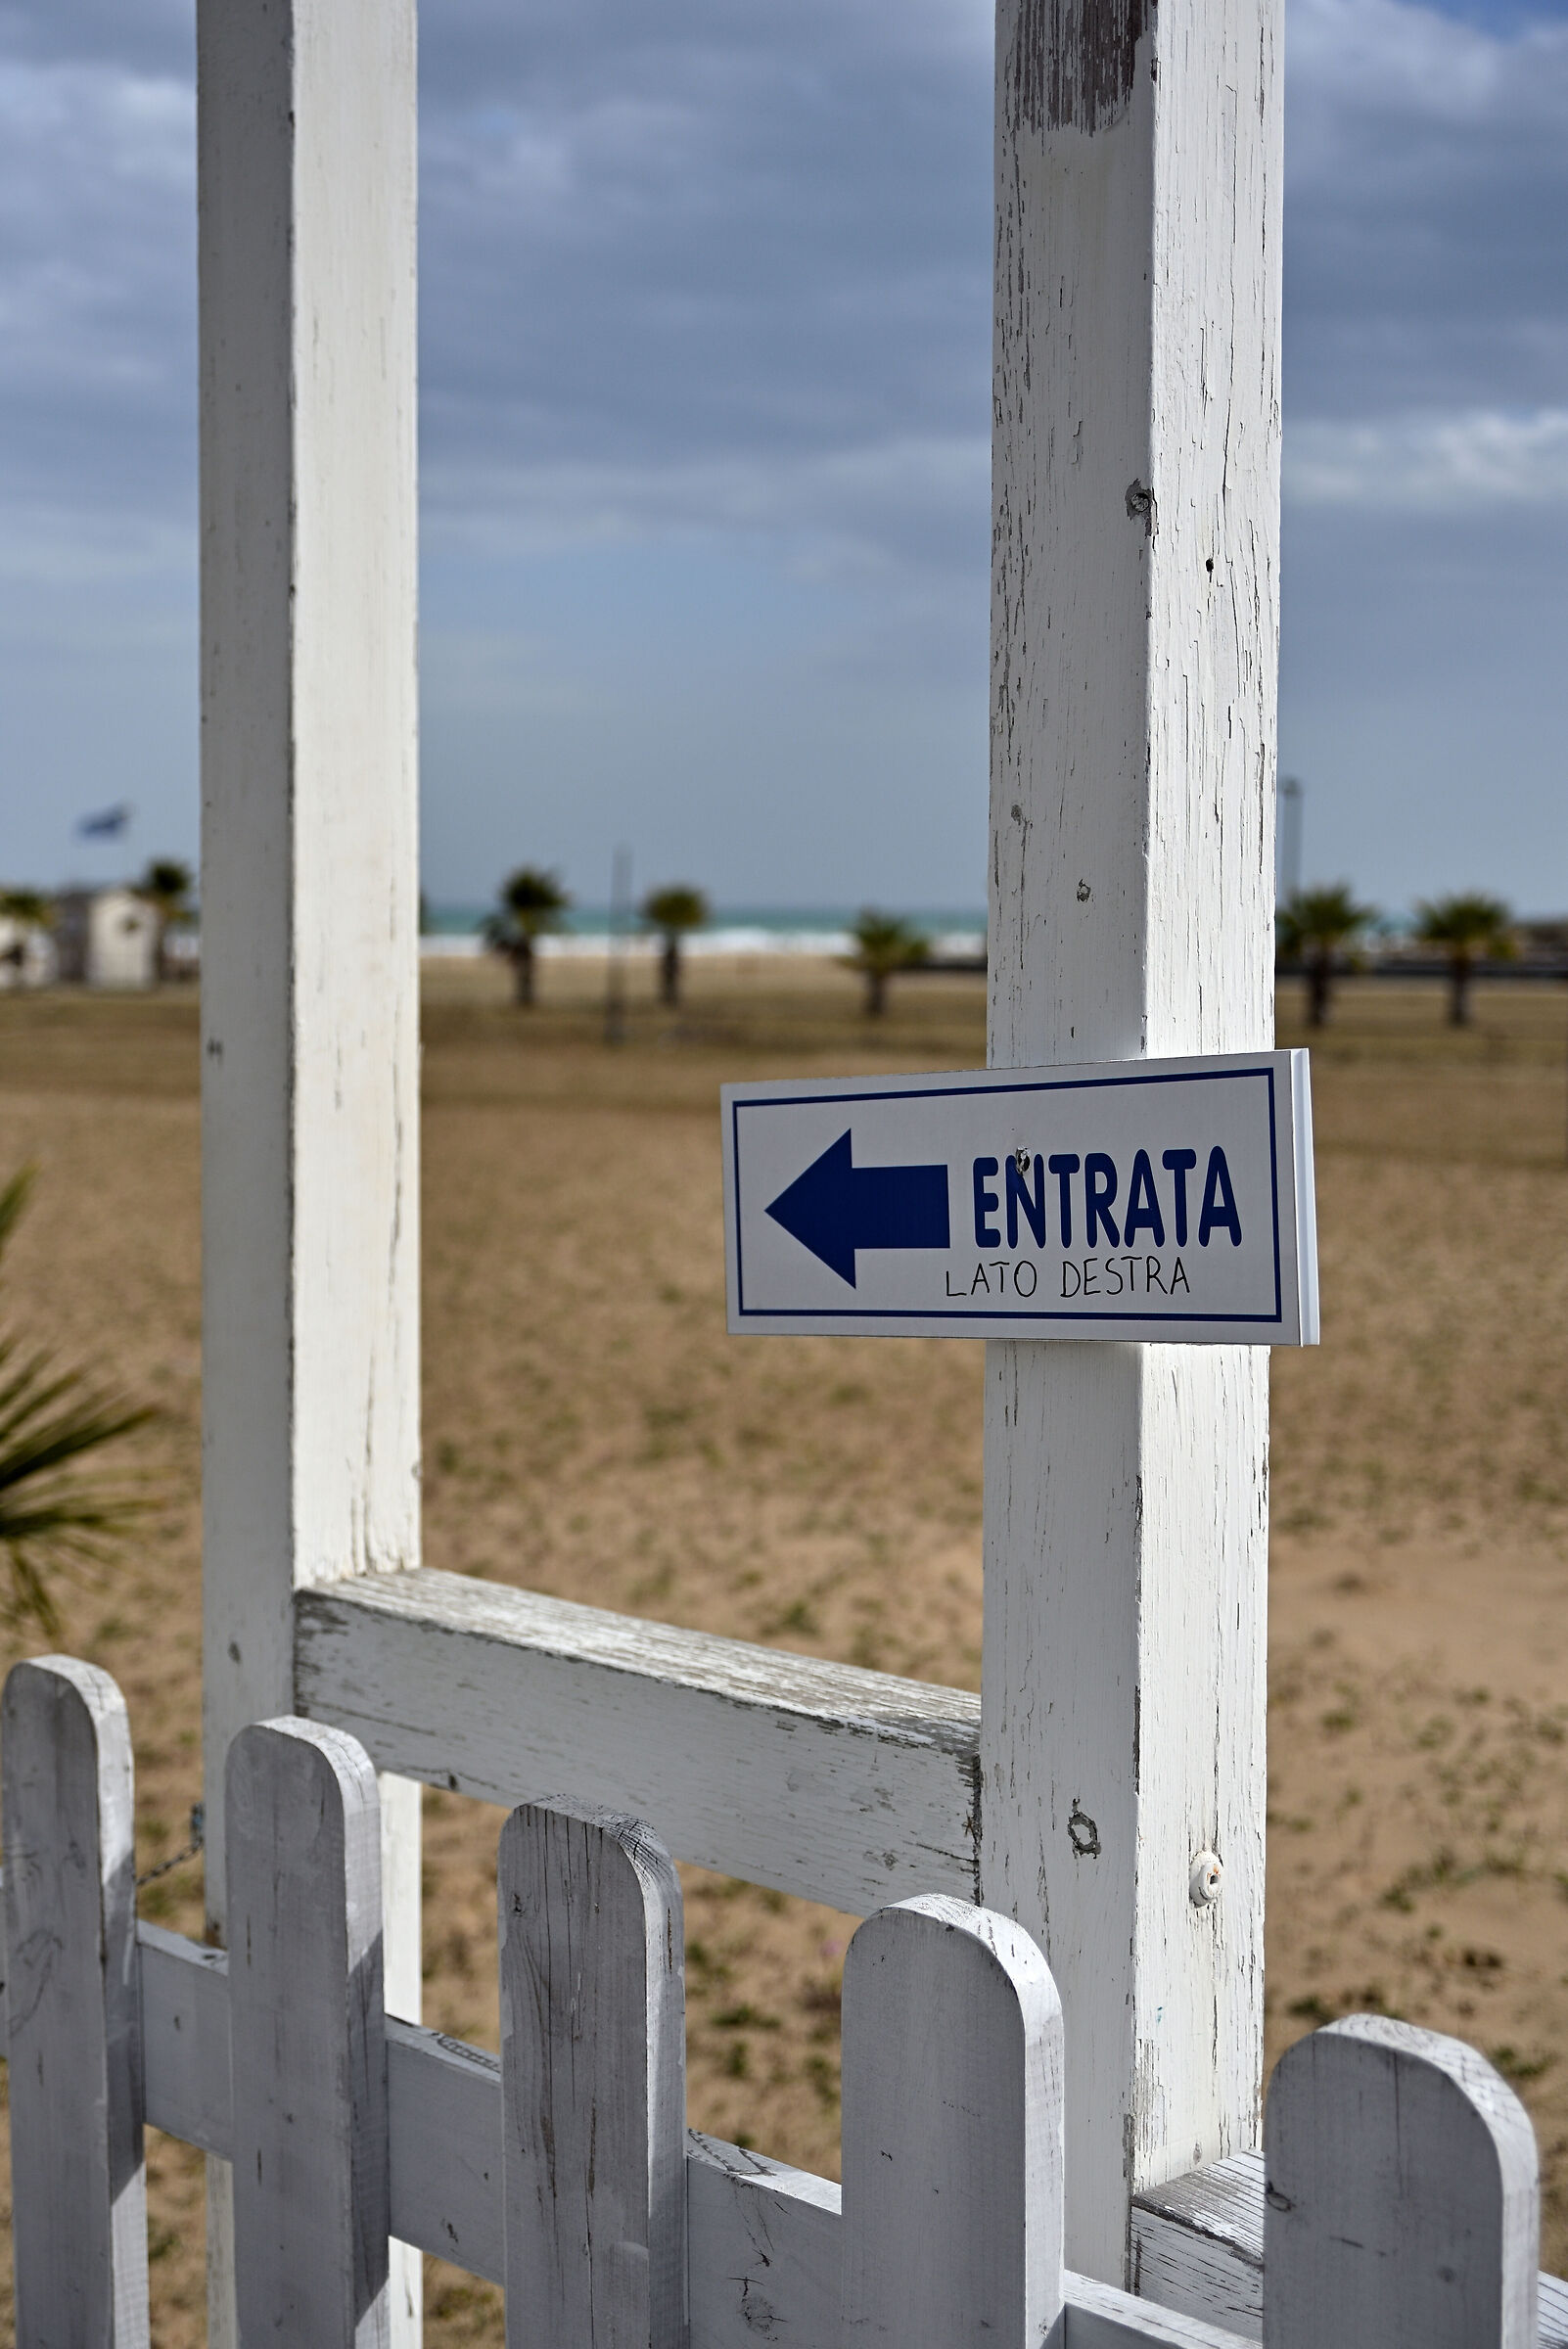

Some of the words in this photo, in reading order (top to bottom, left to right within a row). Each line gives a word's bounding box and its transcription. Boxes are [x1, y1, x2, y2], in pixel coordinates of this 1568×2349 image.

[972, 1145, 1243, 1250] ENTRATA
[945, 1260, 1038, 1299] LATO
[1060, 1255, 1190, 1300] DESTRA
